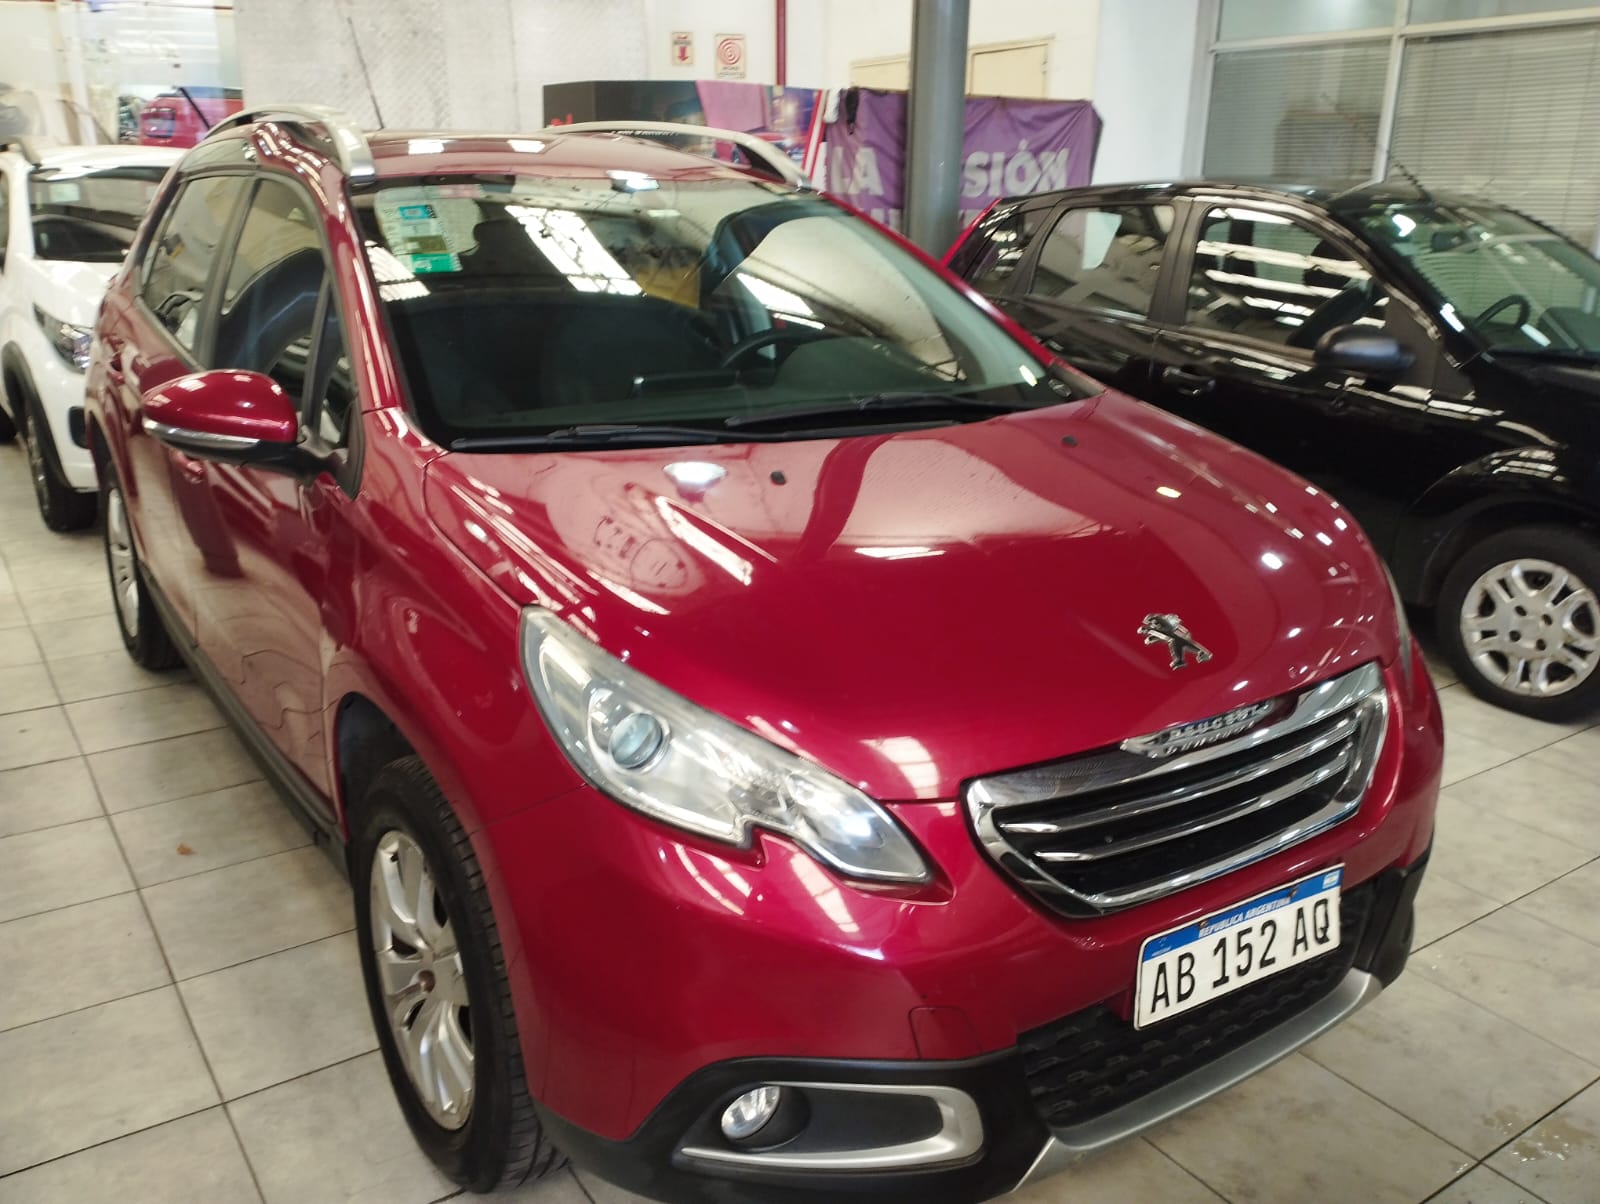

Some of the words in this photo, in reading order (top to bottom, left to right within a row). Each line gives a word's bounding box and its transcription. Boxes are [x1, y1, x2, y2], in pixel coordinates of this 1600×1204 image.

[829, 146, 884, 196] LA
[961, 138, 1071, 198] SIÓN
[1244, 896, 1291, 920] ARGENTINA
[1151, 952, 1196, 1013] AB
[1212, 919, 1277, 988] 152
[1292, 898, 1330, 957] AQ
